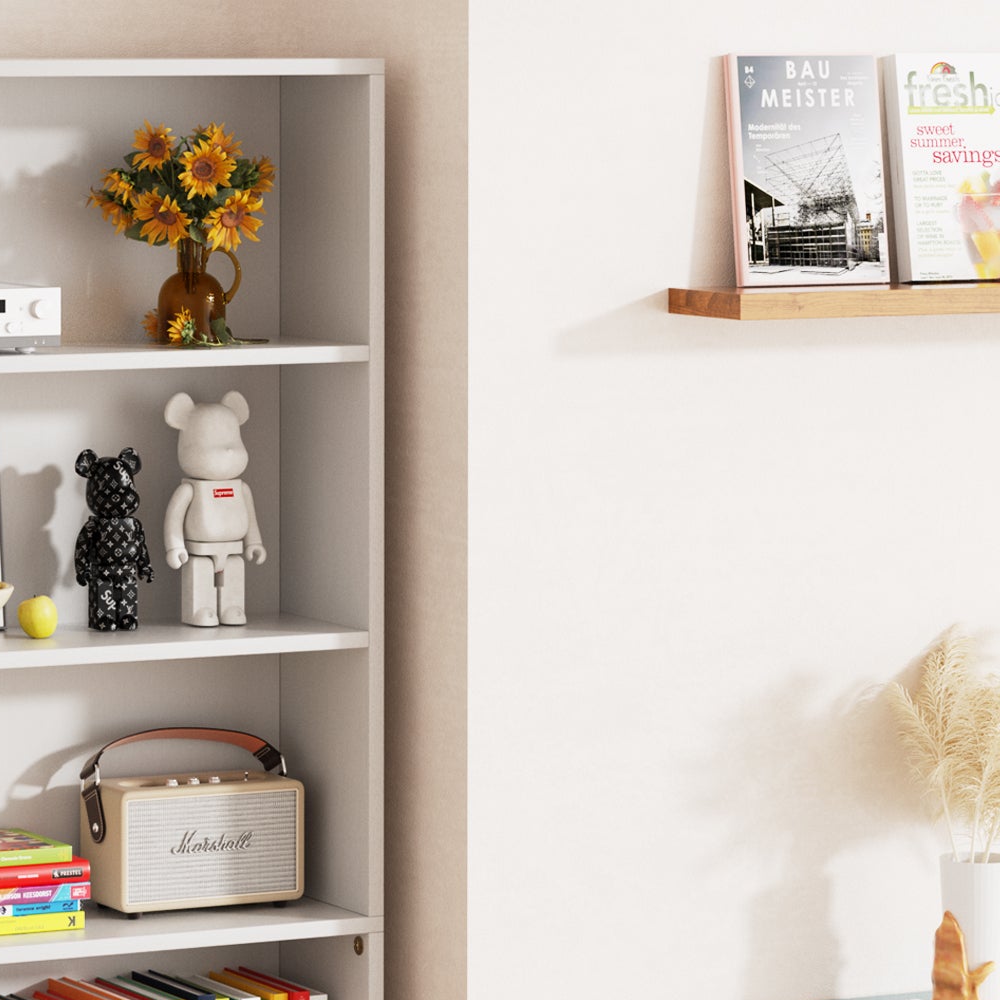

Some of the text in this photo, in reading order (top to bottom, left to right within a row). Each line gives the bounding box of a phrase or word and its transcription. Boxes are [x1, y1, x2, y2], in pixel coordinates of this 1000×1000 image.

[785, 60, 830, 80] BAU
[761, 88, 855, 108] MEISTER
[916, 124, 955, 136] sweet
[910, 138, 965, 148] summer
[171, 830, 254, 855] Marshall
